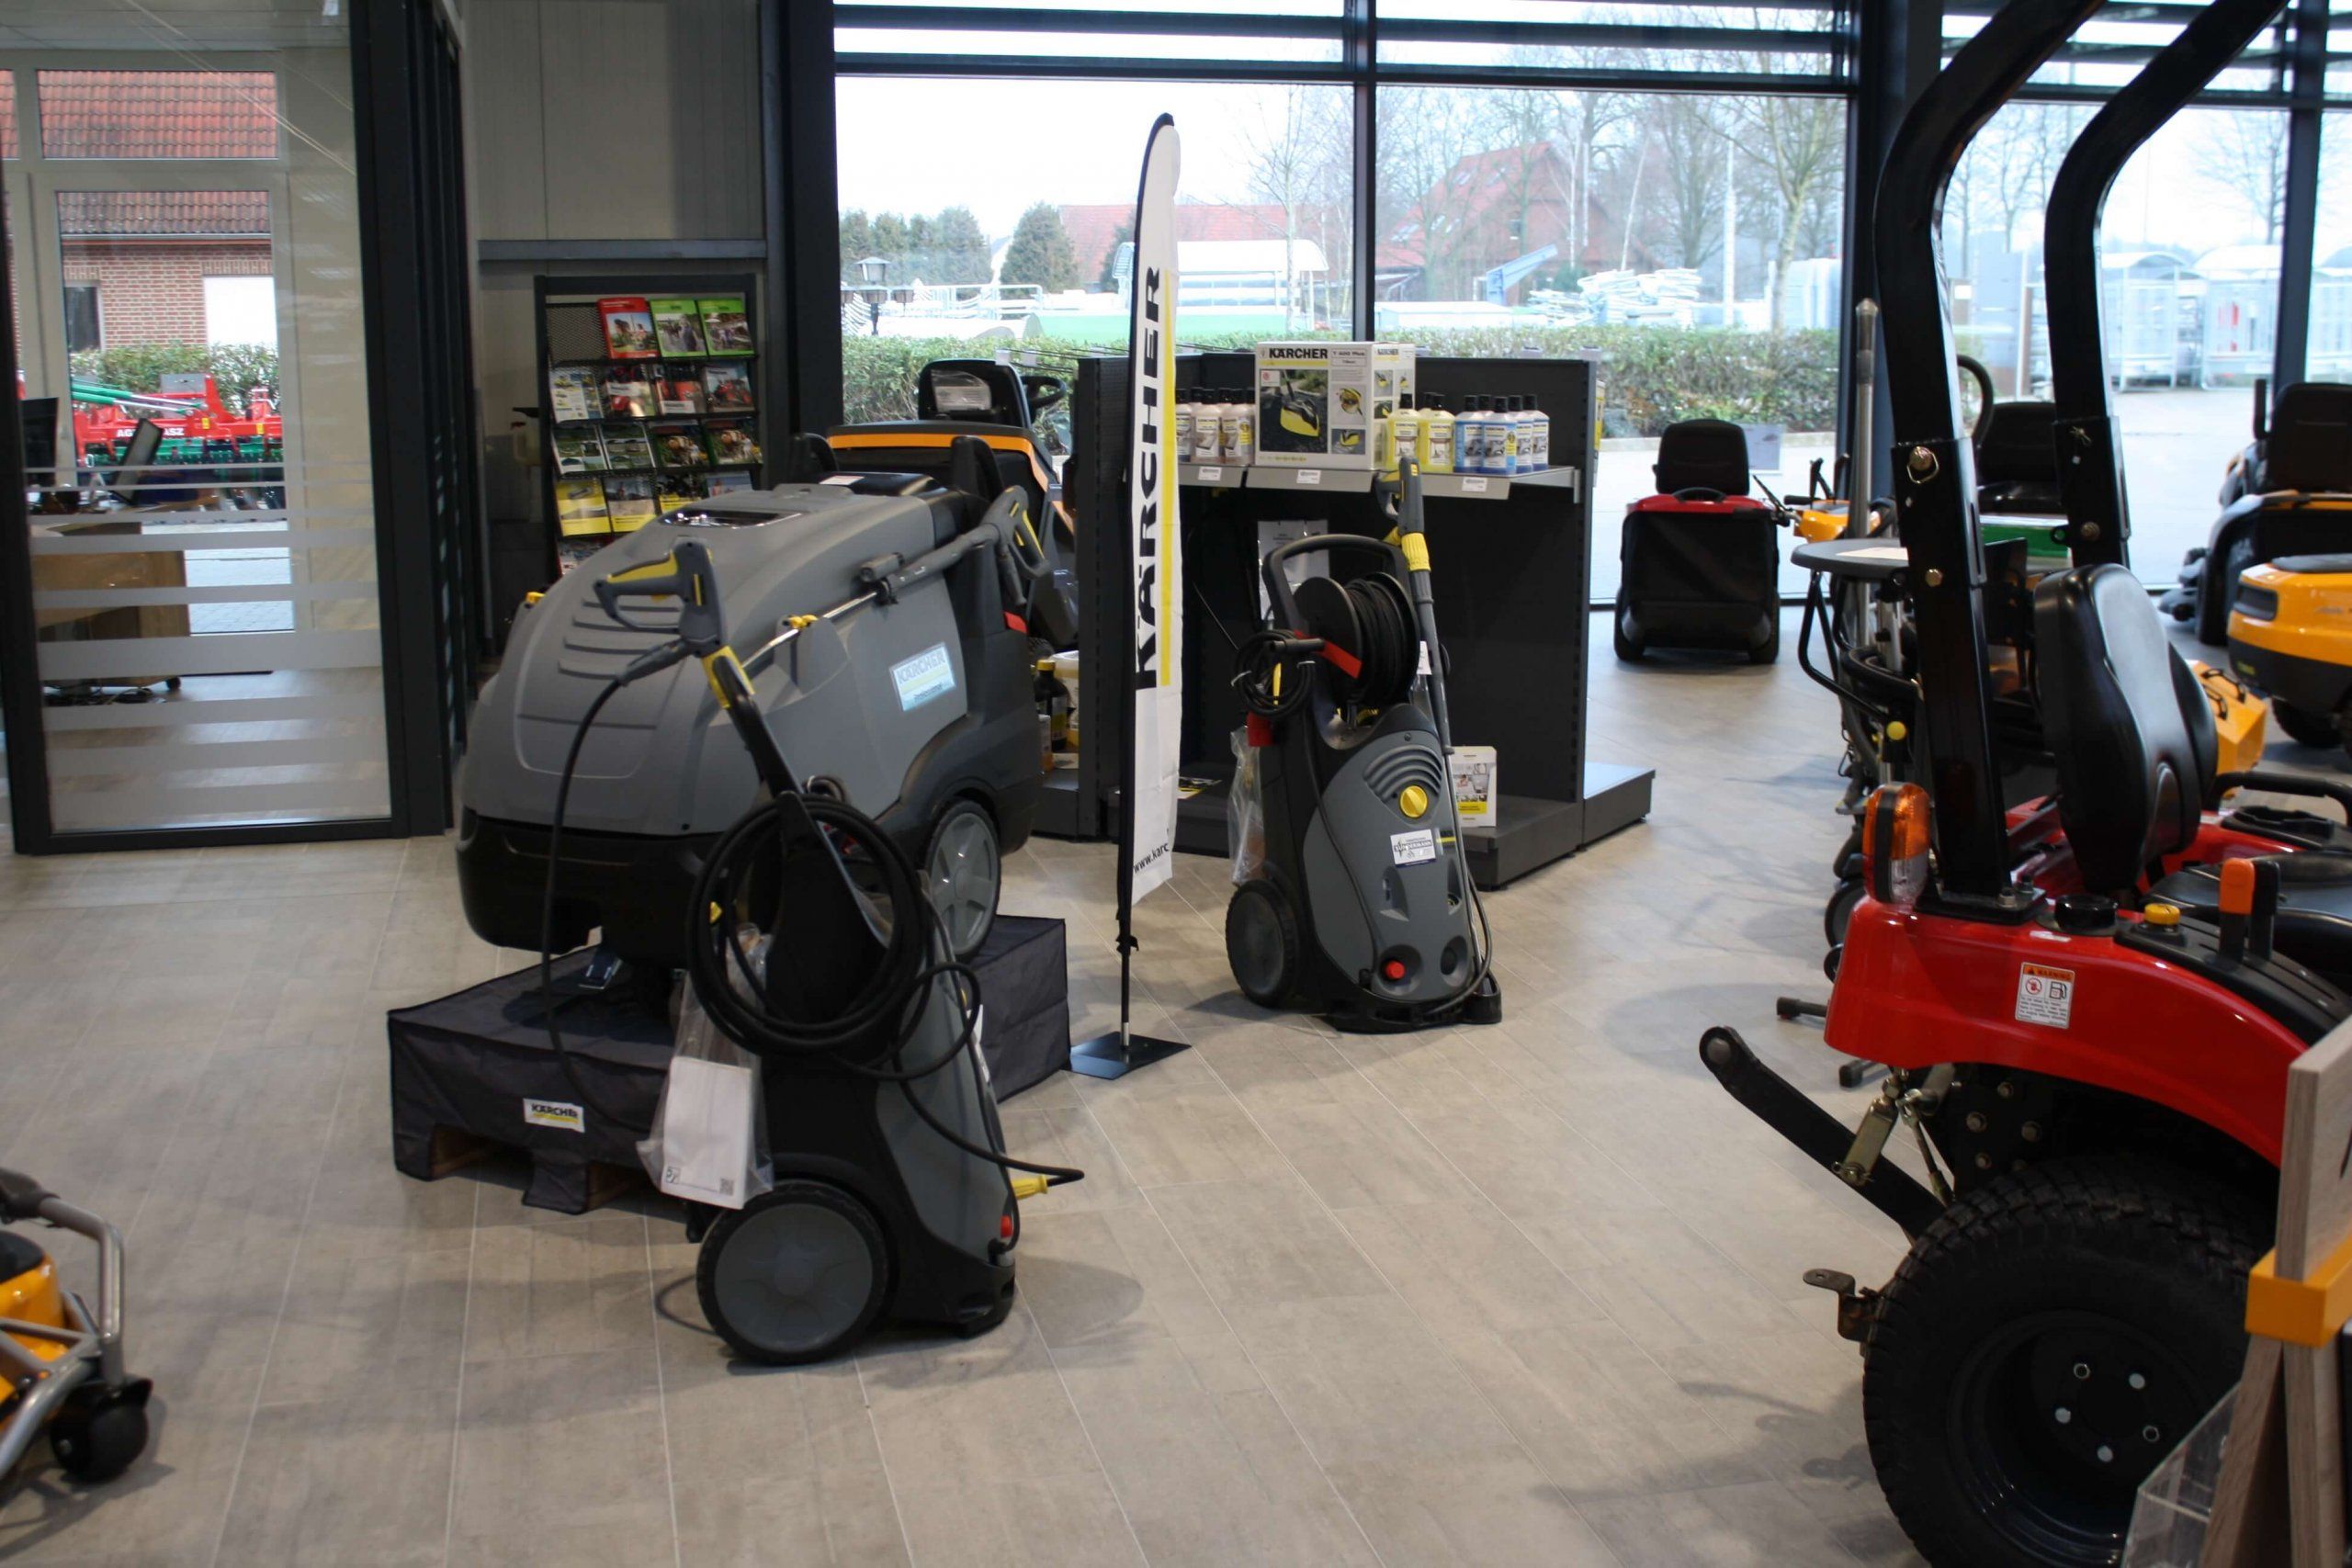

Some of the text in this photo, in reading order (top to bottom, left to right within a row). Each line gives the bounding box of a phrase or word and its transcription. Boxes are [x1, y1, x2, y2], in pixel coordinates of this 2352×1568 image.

[1269, 347, 1329, 359] KÄRCHER
[1135, 266, 1159, 689] KÄRCHER
[897, 652, 946, 683] KÄRCHER
